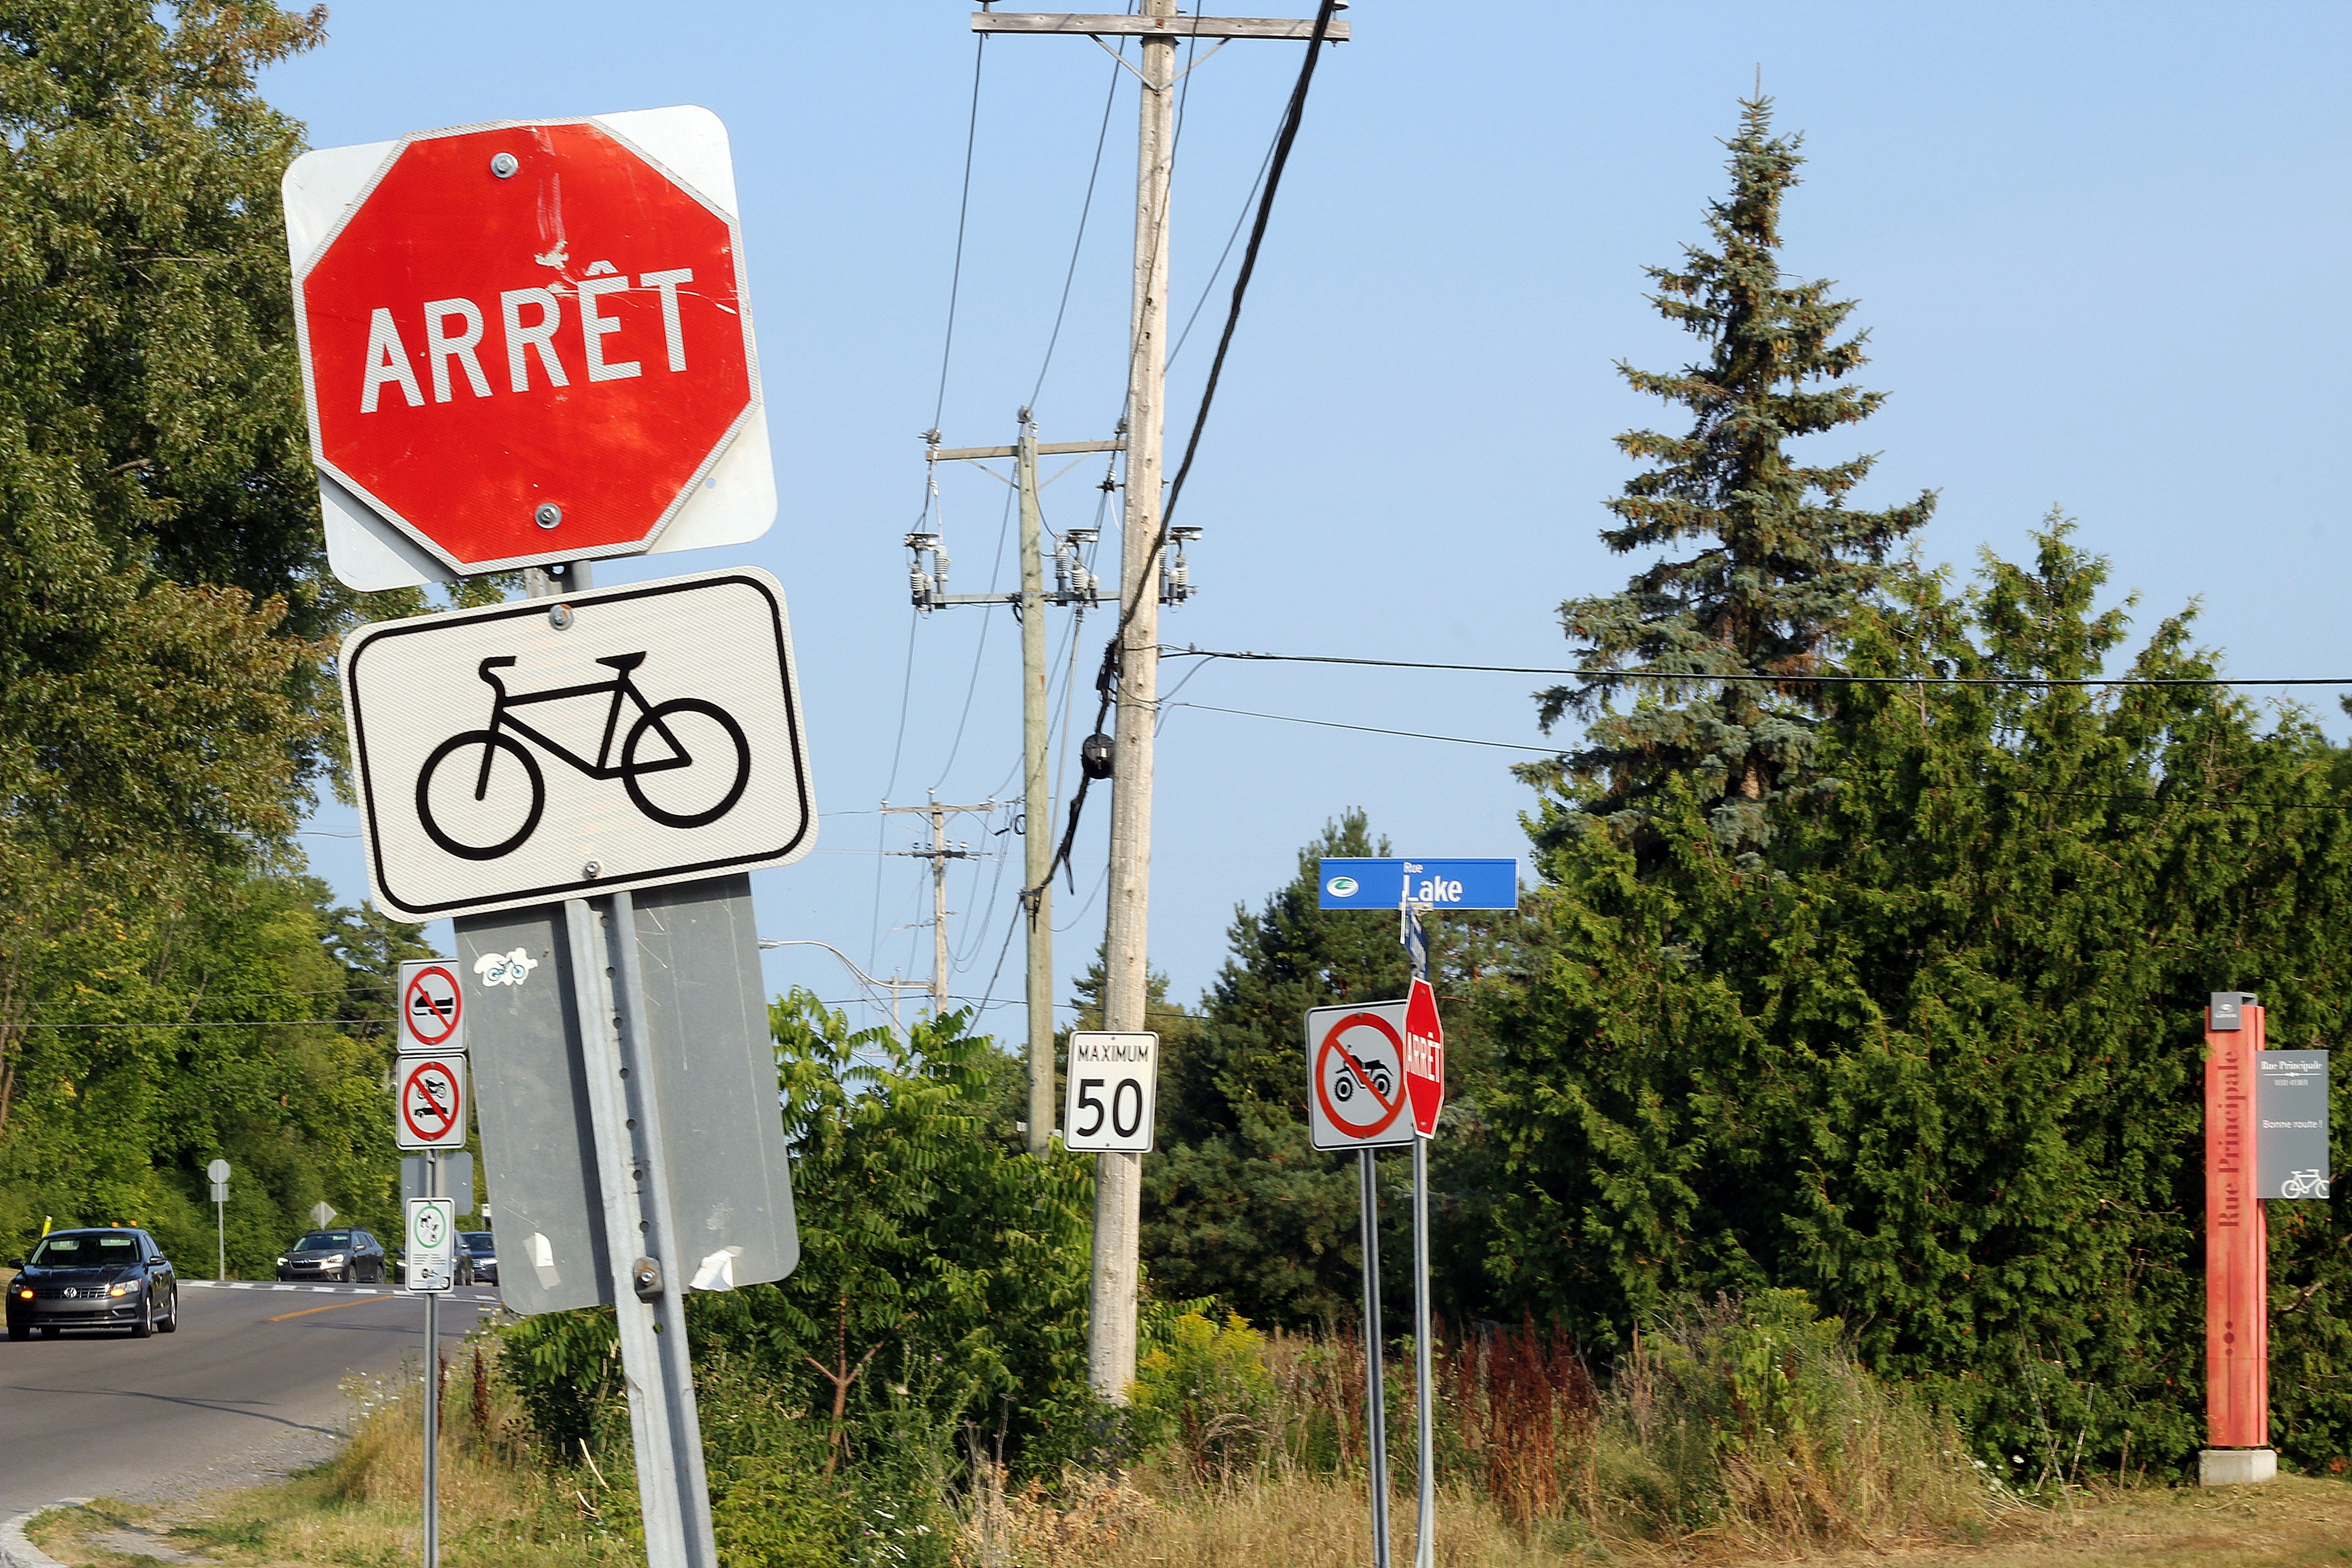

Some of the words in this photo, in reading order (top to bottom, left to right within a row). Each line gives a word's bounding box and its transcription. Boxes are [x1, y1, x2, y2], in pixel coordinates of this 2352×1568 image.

[360, 260, 694, 413] ARRÊT
[1403, 862, 1424, 873] Rue
[1403, 874, 1463, 902] Lake
[1077, 1045, 1149, 1062] MAXIMUM
[1406, 1031, 1441, 1083] ARRÊT
[1076, 1078, 1142, 1137] 50
[2218, 1050, 2246, 1173] Principale
[2262, 1119, 2291, 1128] Bonne
[2218, 1182, 2239, 1227] Rue
